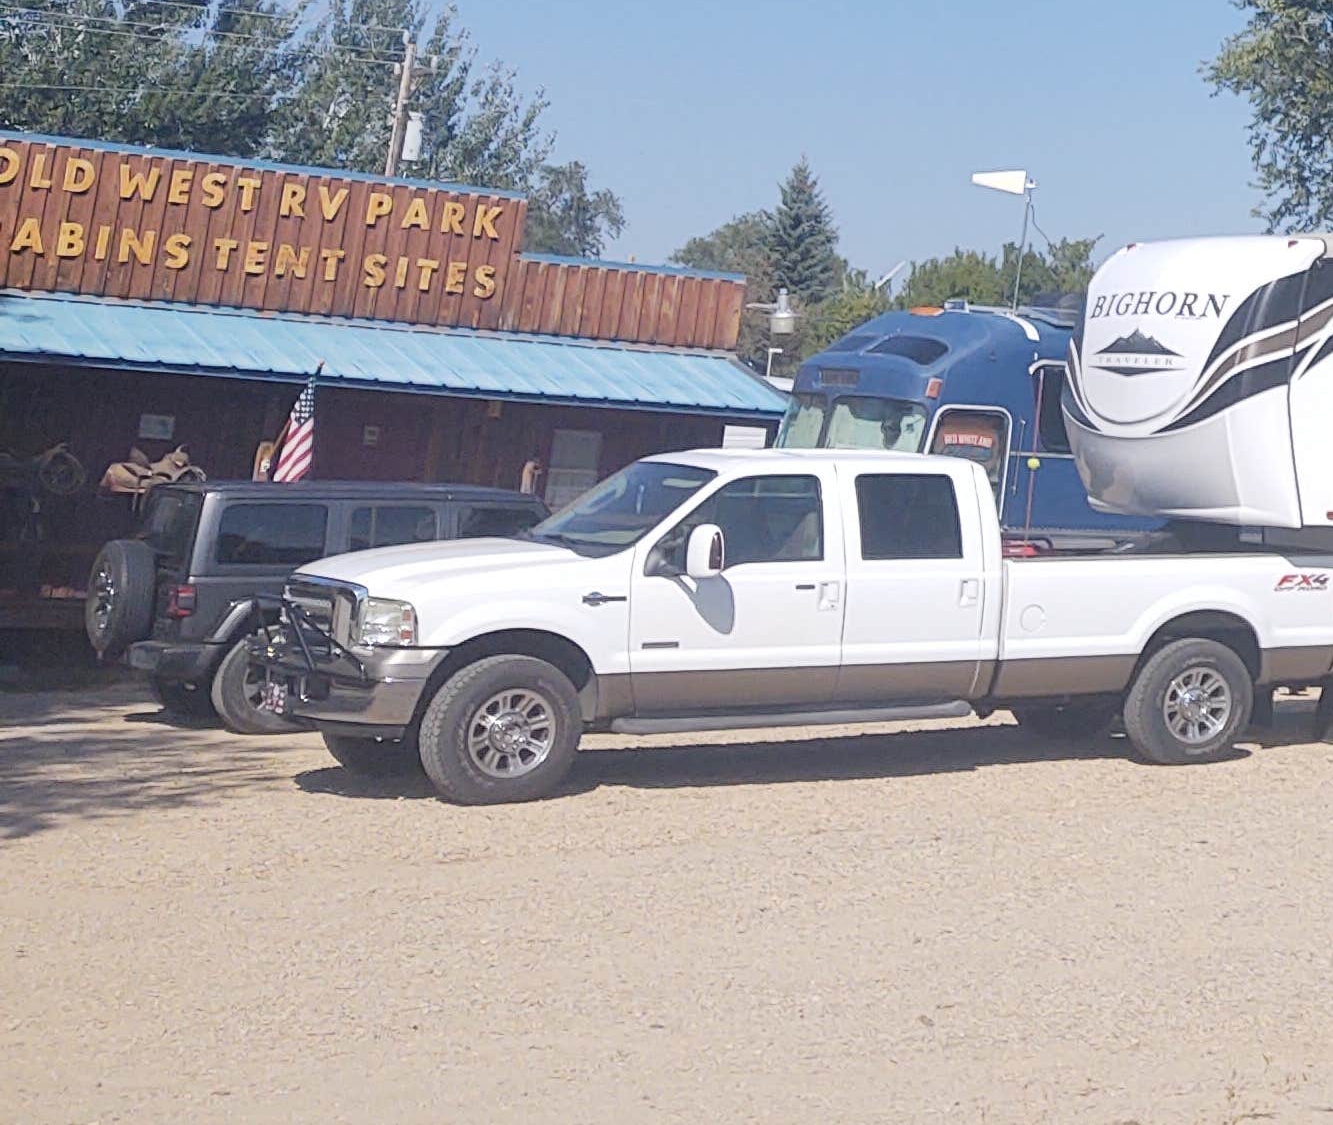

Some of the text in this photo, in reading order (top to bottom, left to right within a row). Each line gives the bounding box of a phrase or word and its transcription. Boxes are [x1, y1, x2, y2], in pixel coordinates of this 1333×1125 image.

[0, 147, 503, 239] OLD WEST RV PARK
[214, 238, 345, 281] TENT
[363, 253, 497, 299] SITES
[1090, 291, 1231, 319] BIGHORN
[1098, 355, 1174, 366] TRAVELER
[1277, 573, 1330, 586] FX4
